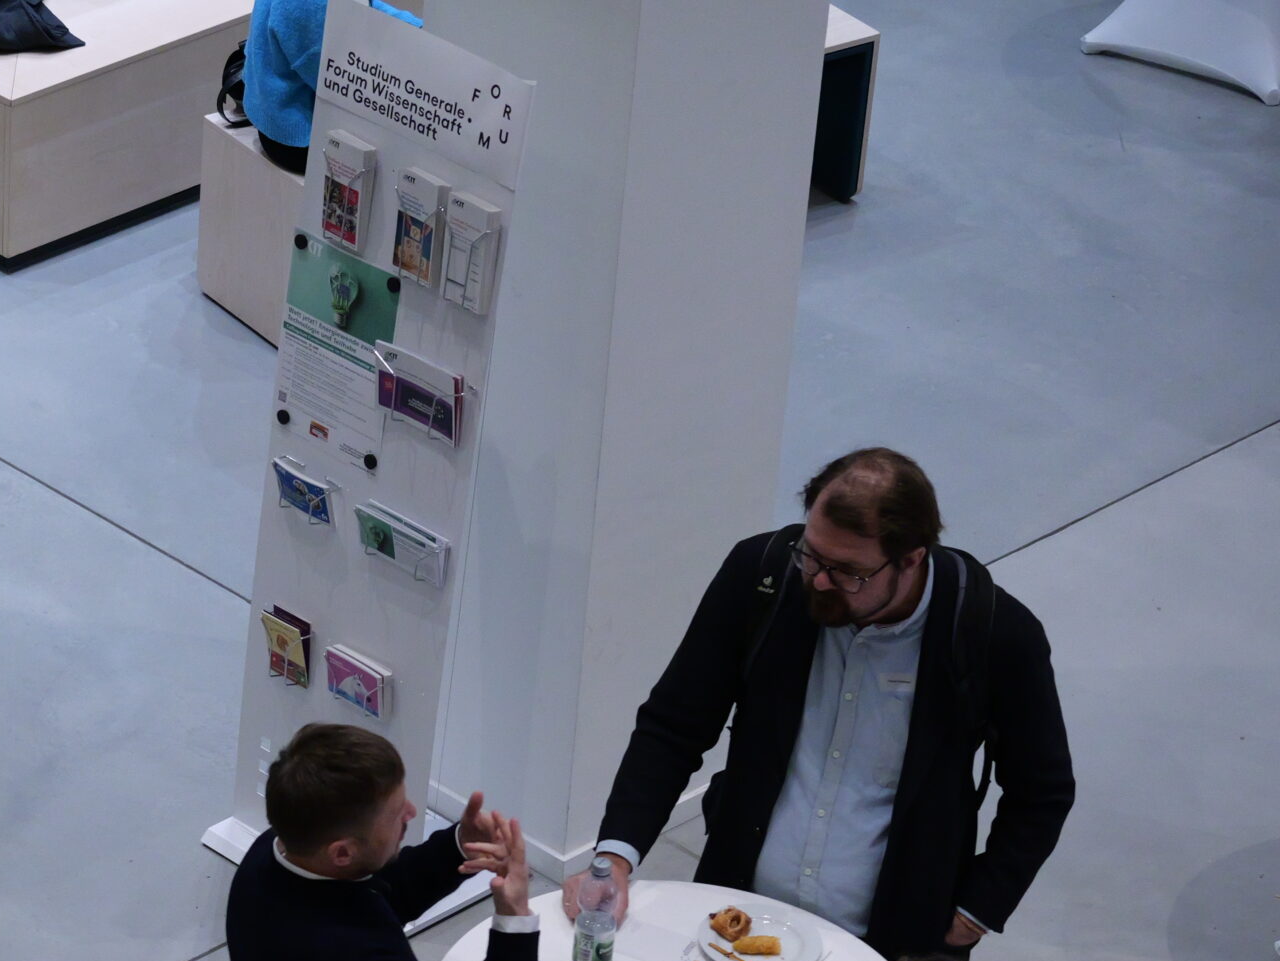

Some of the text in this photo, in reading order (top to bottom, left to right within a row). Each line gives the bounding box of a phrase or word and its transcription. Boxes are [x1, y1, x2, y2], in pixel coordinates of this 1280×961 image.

[323, 76, 438, 141] und Gesellschaft
[326, 58, 462, 136] Forum Wissenschaft
[346, 51, 465, 119] Studium Generale
